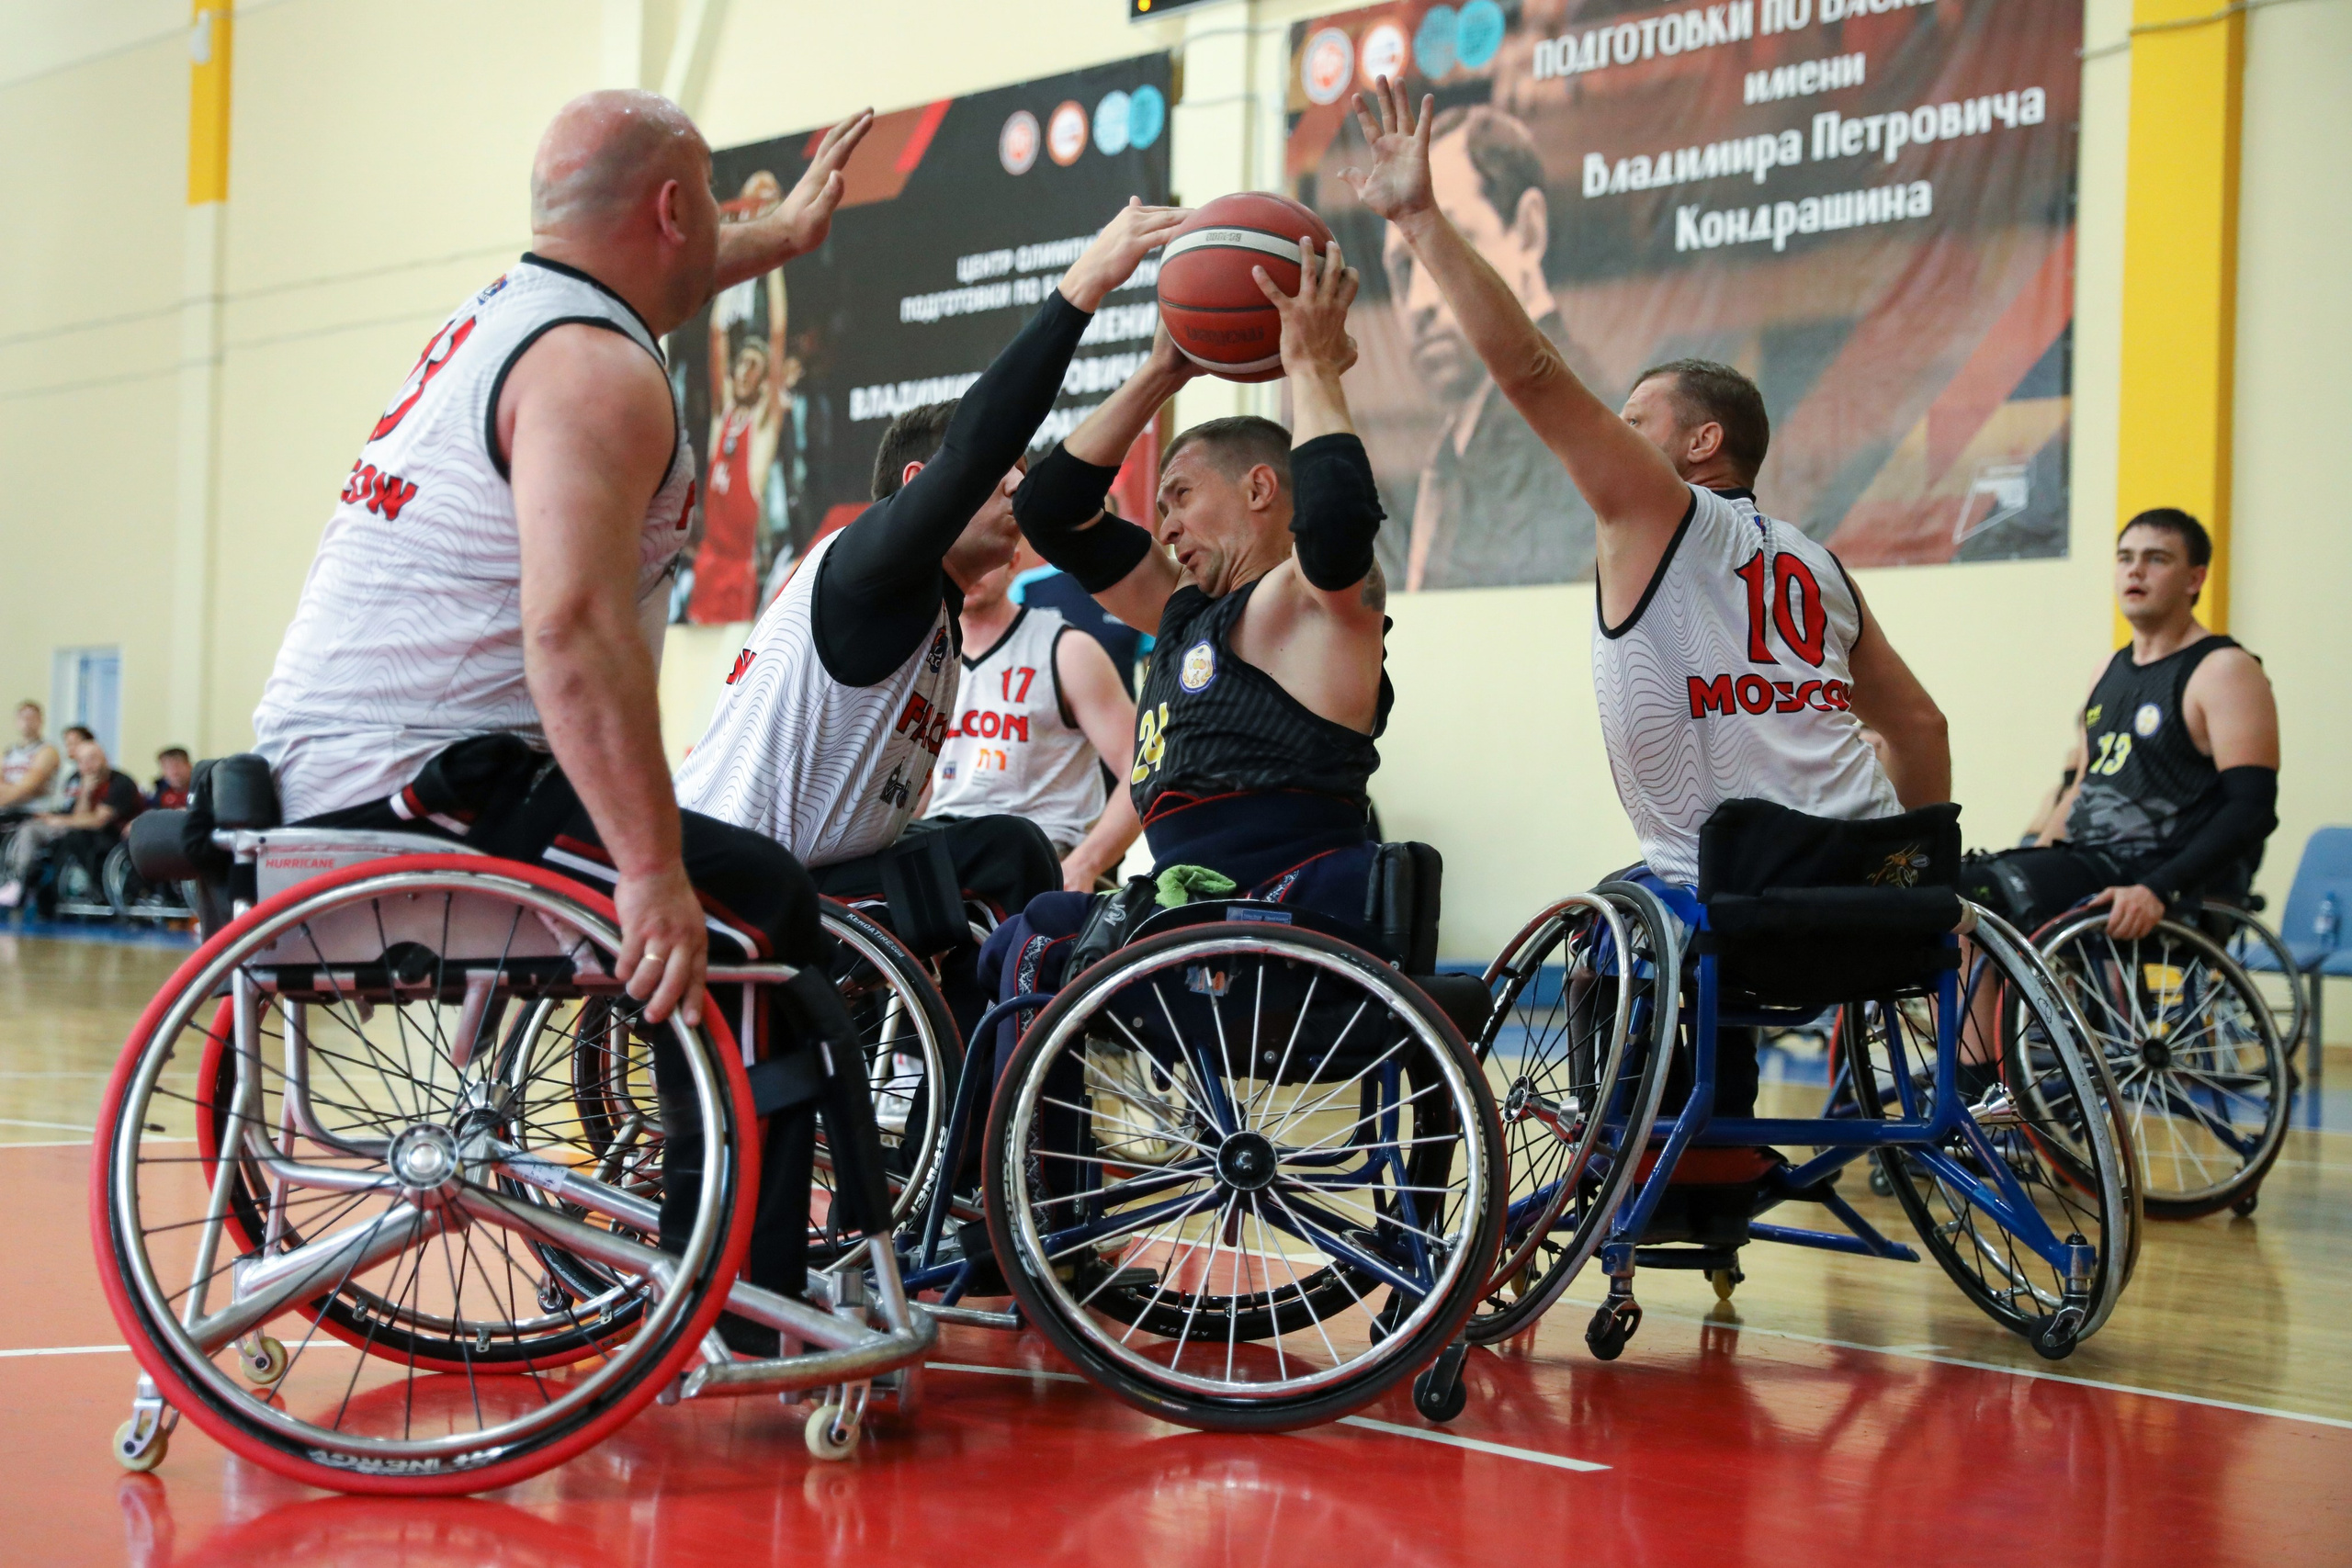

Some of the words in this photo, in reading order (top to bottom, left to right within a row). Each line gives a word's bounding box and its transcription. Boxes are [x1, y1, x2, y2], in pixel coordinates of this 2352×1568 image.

[1532, 0, 1755, 81] ПОДГОТОВКИ
[1744, 51, 1866, 106] имени
[1582, 127, 1804, 199] Владимира
[1811, 85, 2046, 164] Петровича
[1674, 178, 1933, 253] Кондрашина
[1734, 547, 1828, 669] 10
[1001, 666, 1037, 704] 17
[265, 857, 335, 870] HURRICANE
